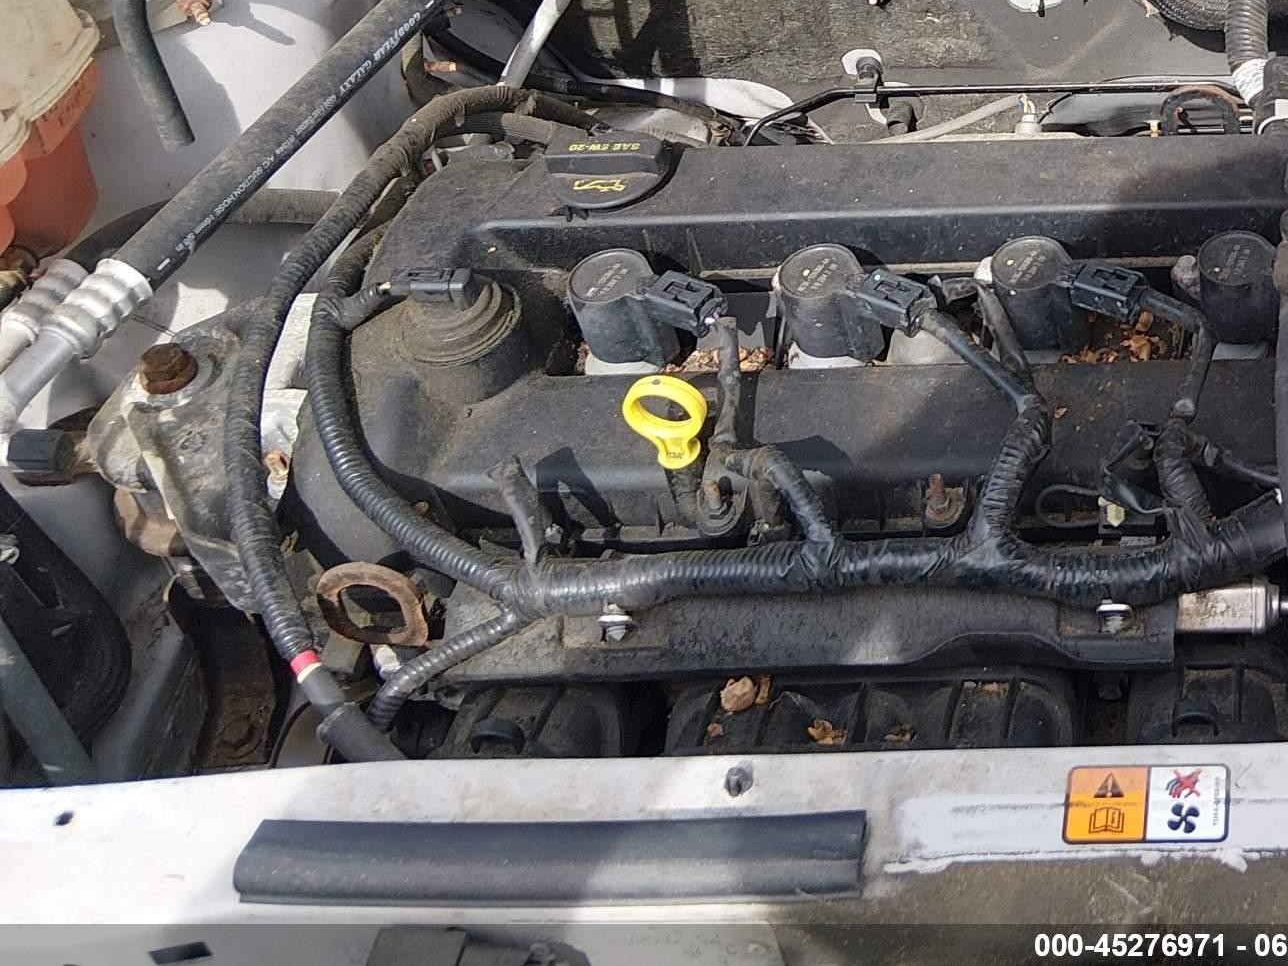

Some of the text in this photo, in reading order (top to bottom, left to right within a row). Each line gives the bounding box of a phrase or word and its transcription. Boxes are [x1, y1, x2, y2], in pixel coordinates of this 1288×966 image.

[373, 12, 420, 61] GOODYEAR
[340, 59, 372, 96] GALAXY
[568, 142, 641, 152] SAE 5W-20
[234, 166, 264, 198] SUCTION
[213, 194, 236, 216] HOSE
